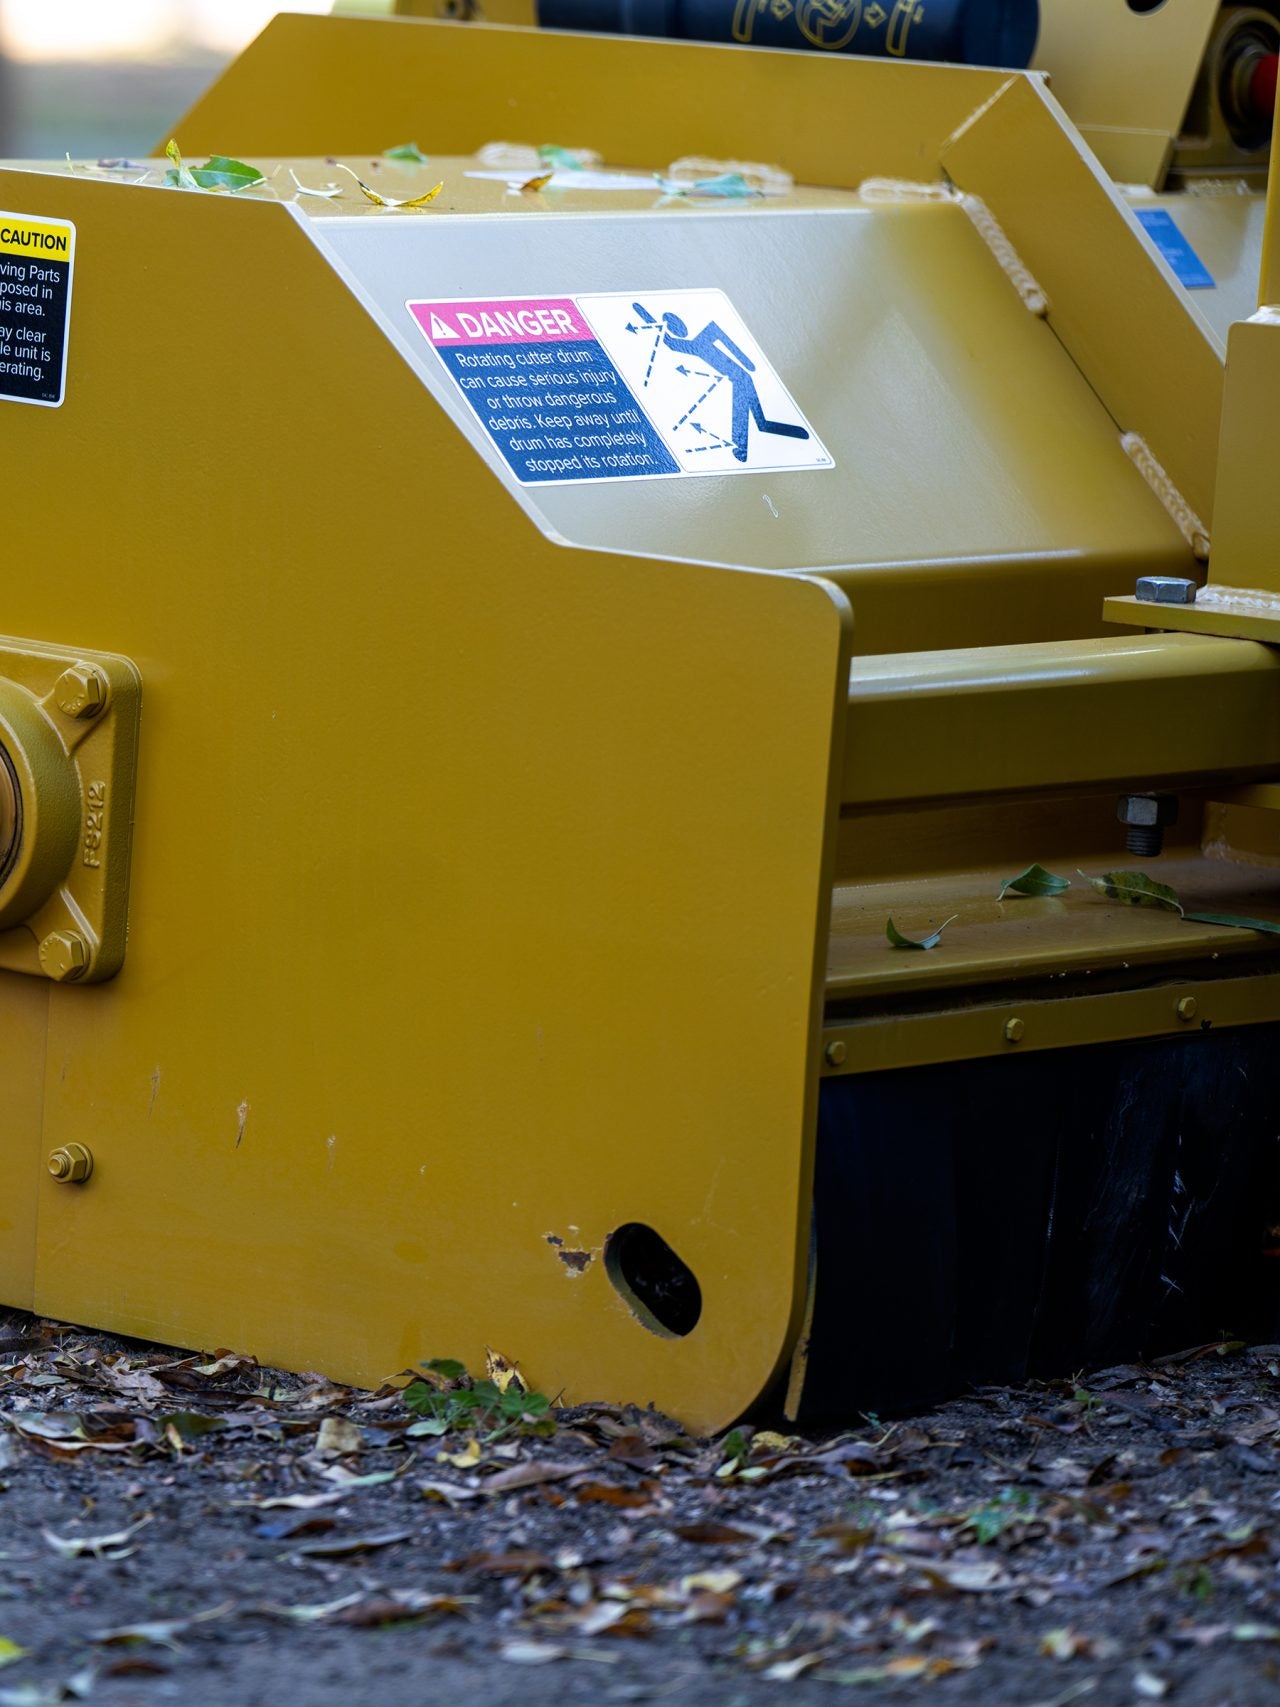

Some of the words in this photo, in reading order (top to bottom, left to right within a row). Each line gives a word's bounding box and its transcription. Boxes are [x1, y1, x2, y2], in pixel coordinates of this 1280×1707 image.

[0, 228, 66, 251] CAUTION
[29, 265, 60, 283] Parts
[41, 285, 53, 299] in
[14, 302, 45, 317] area.
[455, 309, 579, 338] DANGER
[16, 327, 46, 343] clear
[14, 346, 38, 360] unit
[41, 347, 51, 362] is
[455, 353, 516, 369] Rotating
[517, 351, 555, 365] cutter
[555, 349, 593, 364] drum
[458, 376, 487, 389] can
[488, 374, 526, 388] cause
[528, 371, 579, 386] serious
[579, 369, 617, 386] injury
[486, 398, 500, 410] or
[502, 394, 542, 408] throw
[544, 391, 617, 409] dangerous
[488, 416, 536, 431] debris.
[533, 414, 573, 430] Keep
[574, 414, 610, 428] away
[611, 409, 641, 424] until
[509, 437, 547, 452] drum
[546, 435, 573, 449] has
[574, 431, 647, 449] completely
[525, 456, 583, 474] stopped
[580, 454, 601, 469] its
[601, 452, 658, 468] rotation.
